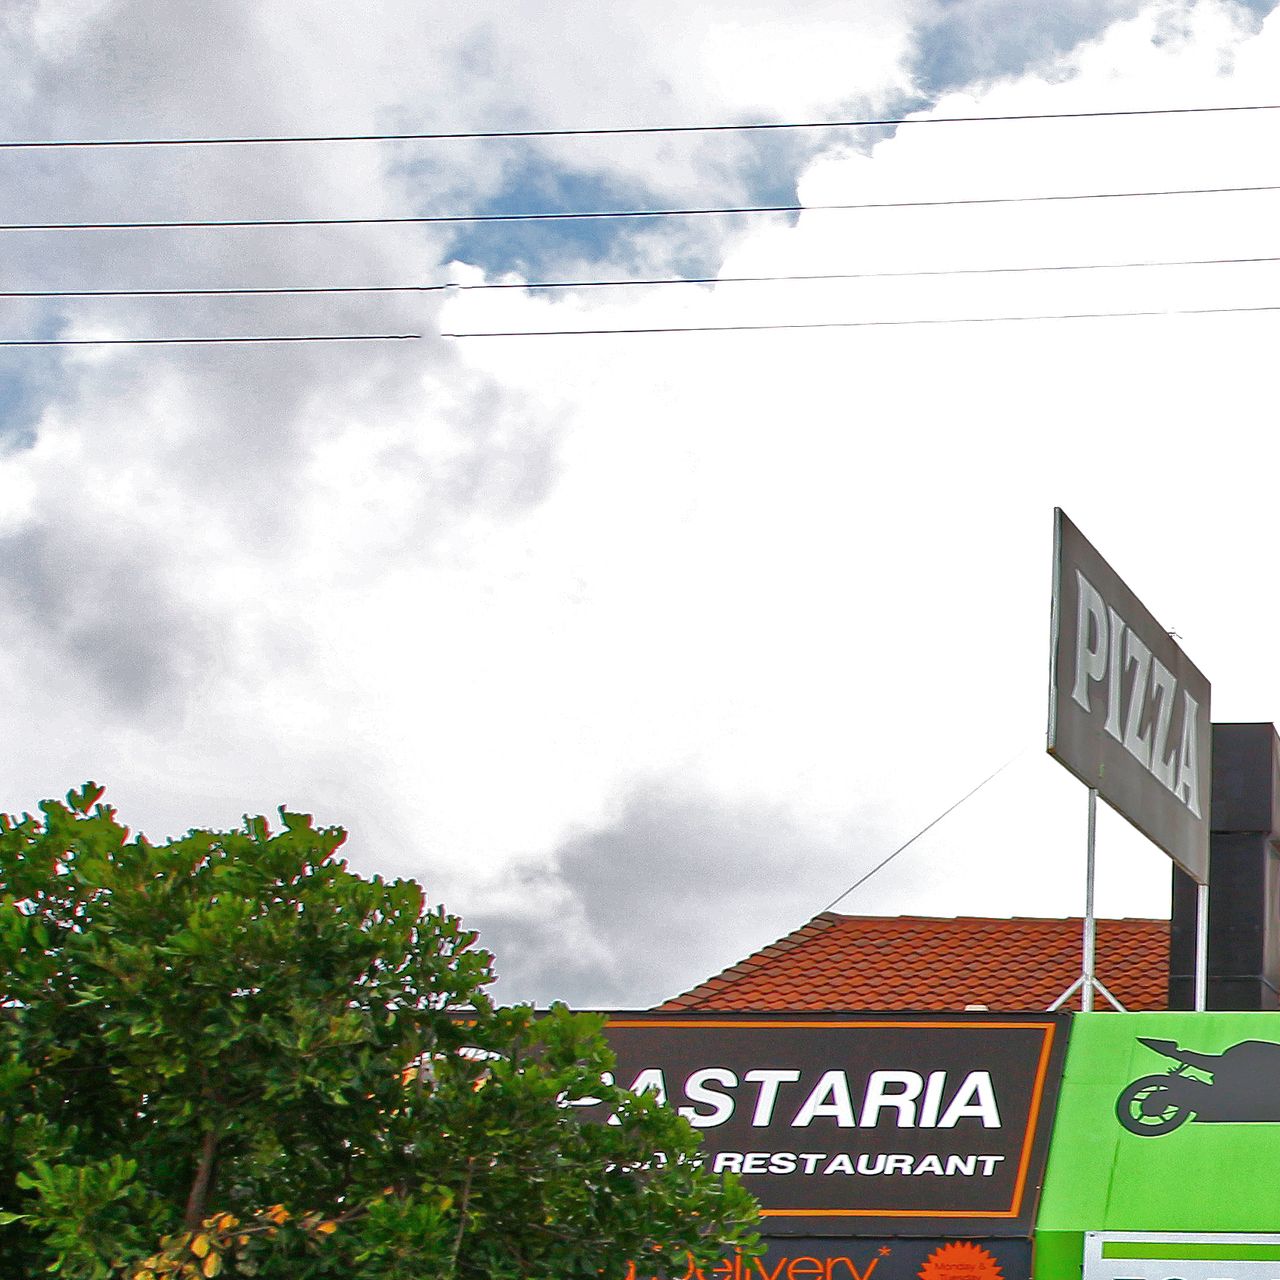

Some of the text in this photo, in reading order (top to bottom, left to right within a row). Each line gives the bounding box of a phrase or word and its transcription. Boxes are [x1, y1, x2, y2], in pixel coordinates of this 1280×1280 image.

[1071, 568, 1201, 820] PIZZA
[556, 1068, 1002, 1129] ASTARIA
[713, 1151, 1005, 1177] RESTAURANT
